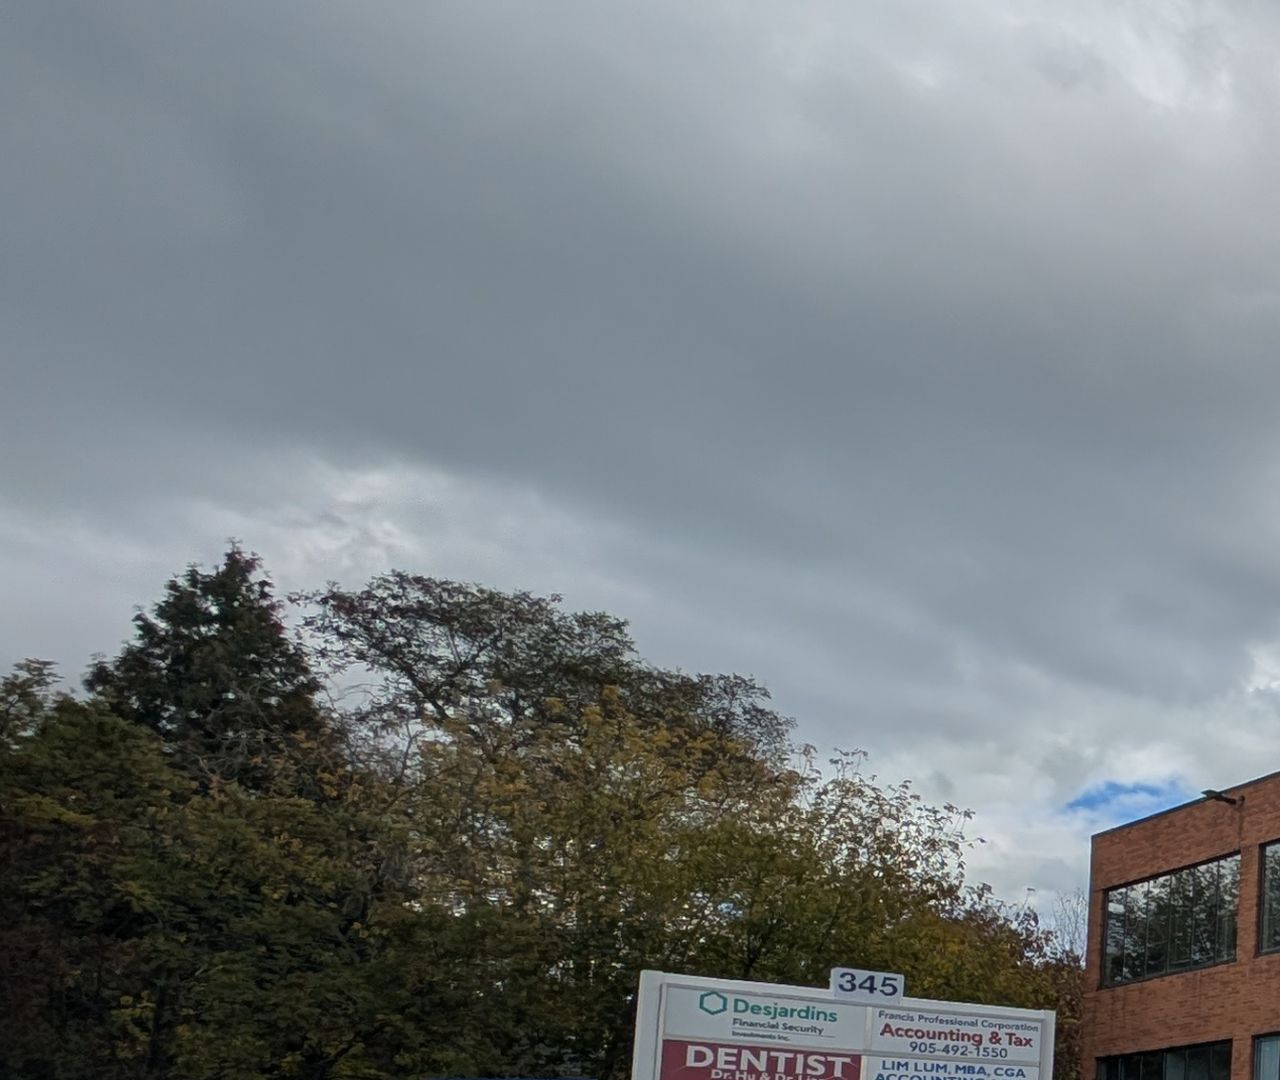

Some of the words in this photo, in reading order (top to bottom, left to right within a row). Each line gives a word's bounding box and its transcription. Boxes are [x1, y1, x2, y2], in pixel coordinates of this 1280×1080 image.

[838, 972, 898, 996] 345
[733, 998, 838, 1022] Desjardins
[879, 1010, 915, 1022] Francis
[918, 1014, 978, 1028] Professional
[981, 1020, 1039, 1032] Corporation
[732, 1017, 779, 1030] Financial
[782, 1022, 825, 1036] Security
[880, 1023, 983, 1047] Accounting
[989, 1031, 1002, 1045] &
[1005, 1032, 1033, 1048] Tax
[685, 1044, 851, 1078] DENTIST
[909, 1041, 1008, 1059] 905-492-1550
[711, 1069, 732, 1080] Dr.
[882, 1060, 909, 1071] LIM
[914, 1062, 950, 1074] LUM,
[955, 1065, 990, 1077] MBA,
[994, 1067, 1026, 1078] CGA
